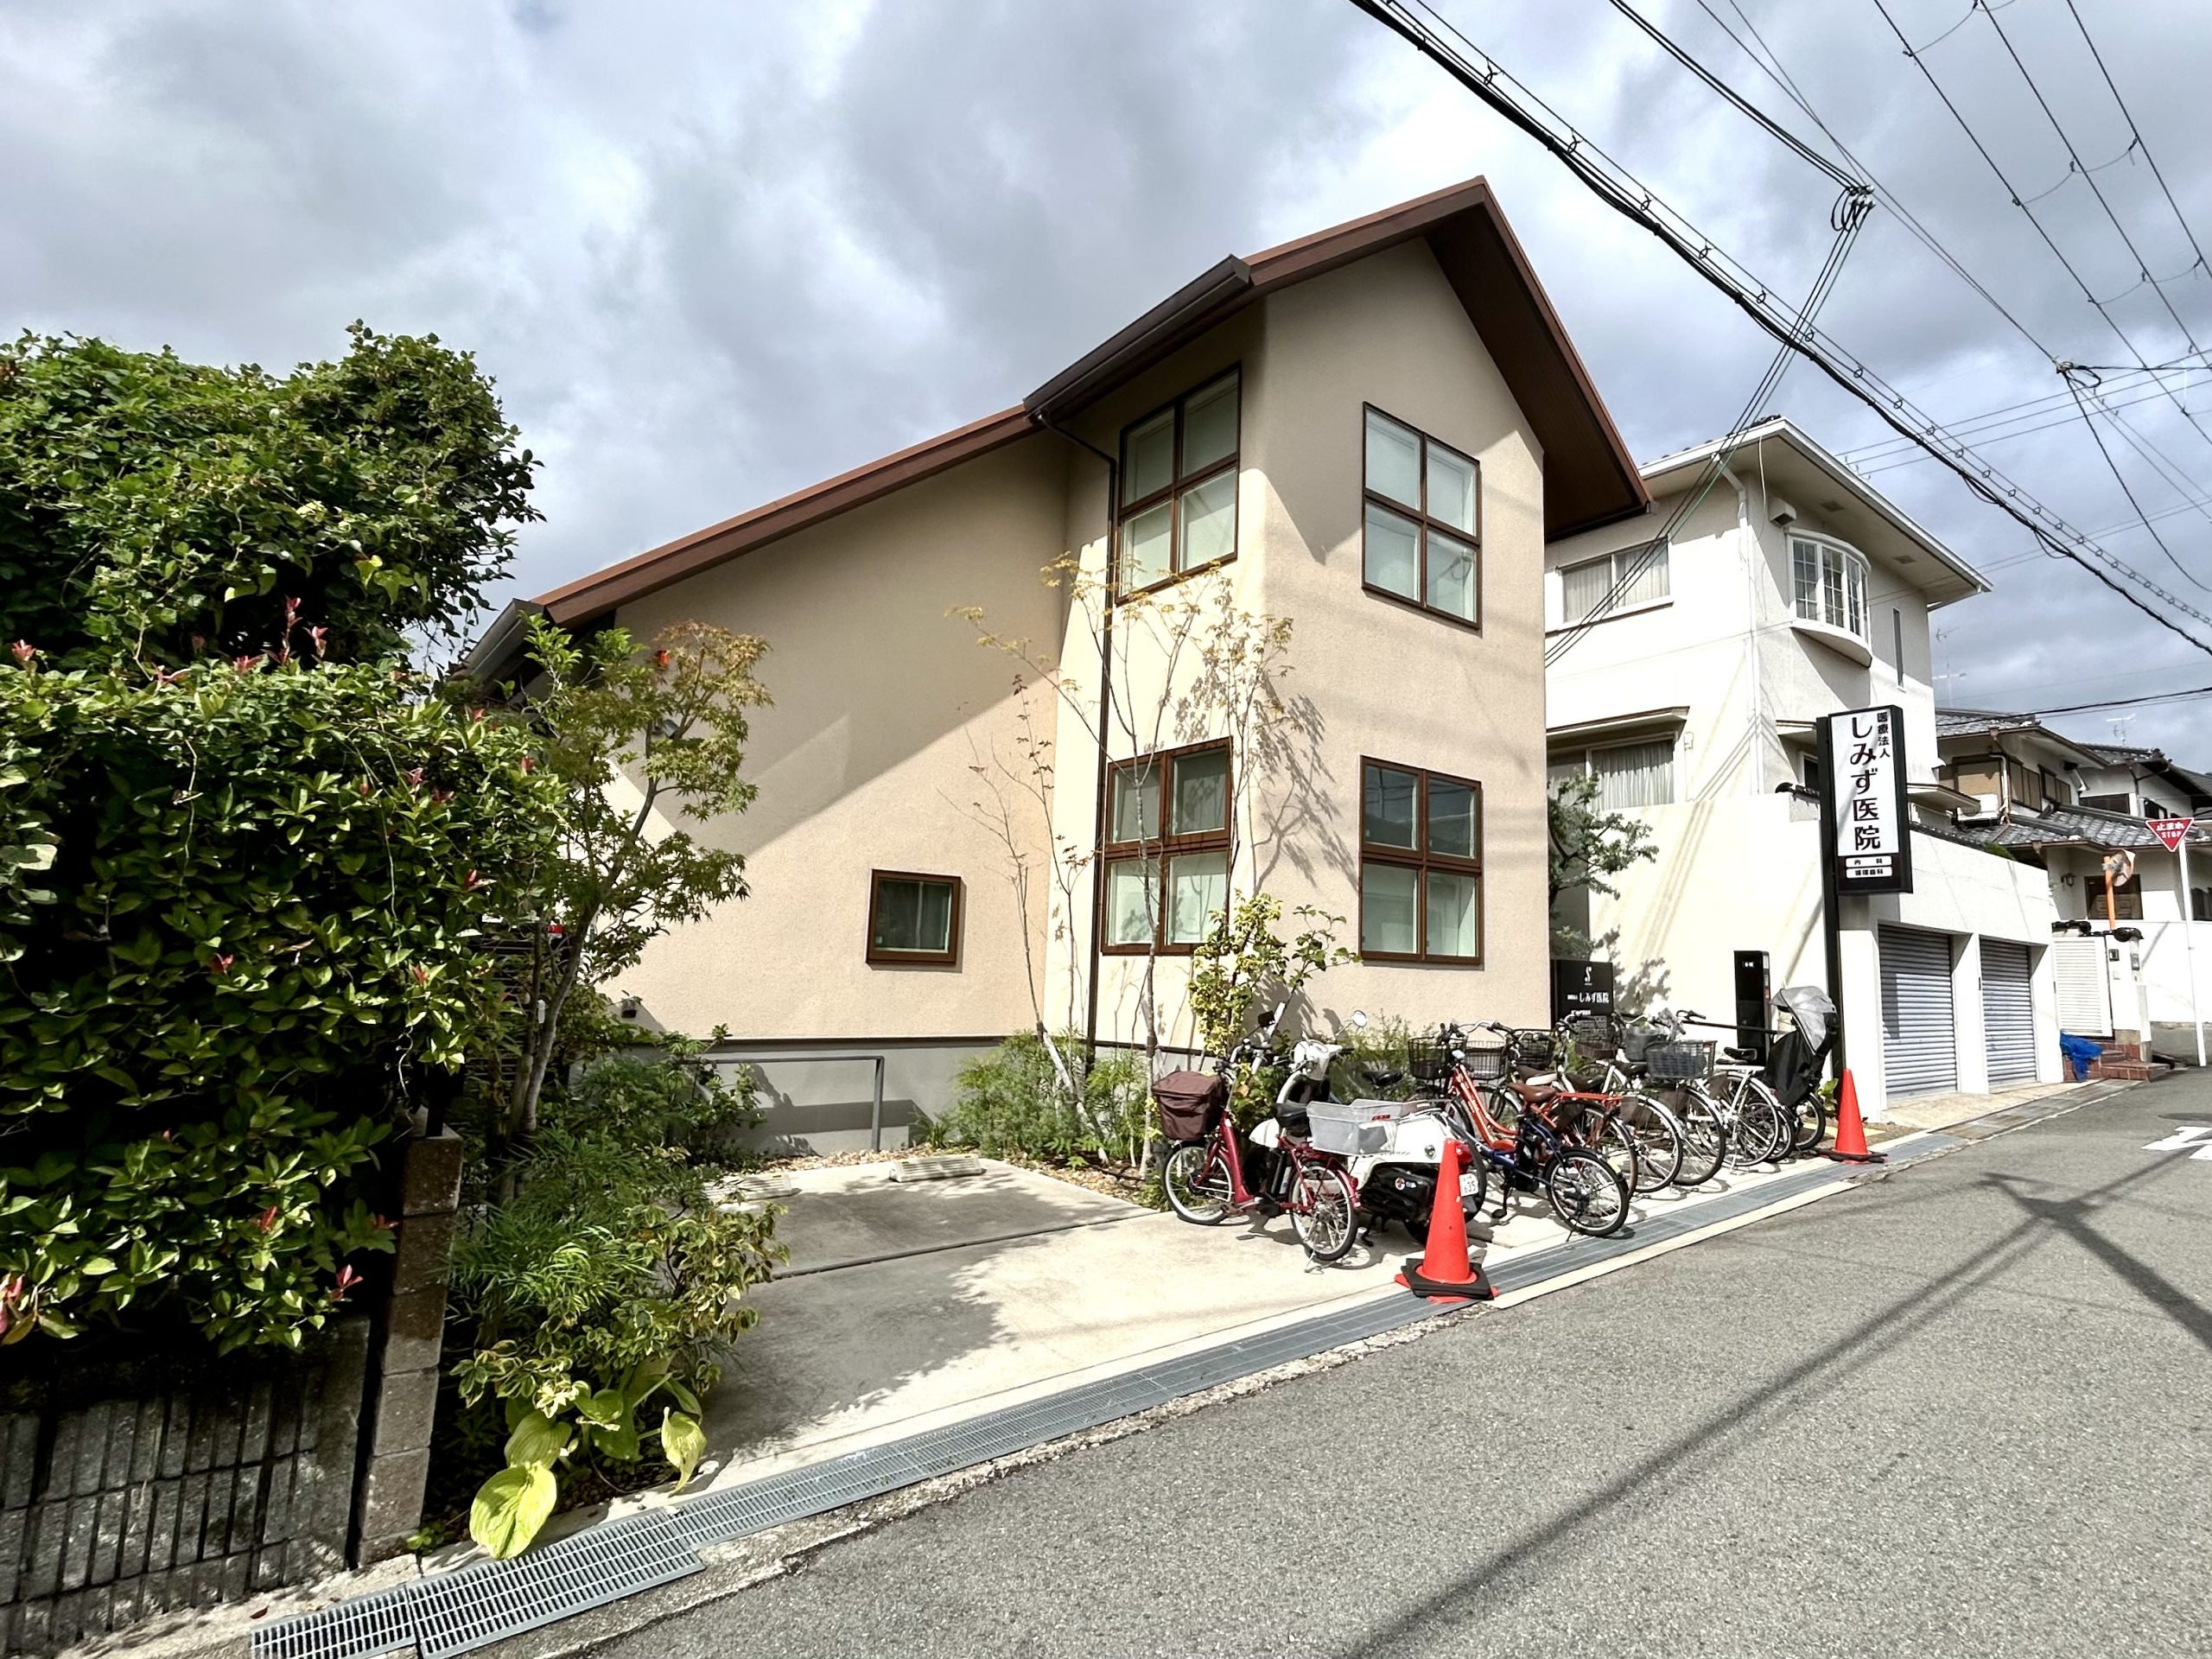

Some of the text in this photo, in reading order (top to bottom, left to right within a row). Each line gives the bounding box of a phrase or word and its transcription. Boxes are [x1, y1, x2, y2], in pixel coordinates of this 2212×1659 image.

[1877, 711, 1891, 759] 医療法人
[1850, 716, 1881, 850] しみず医院
[2156, 821, 2185, 831] 止まれ
[1579, 992, 1610, 1004] しみず医院
